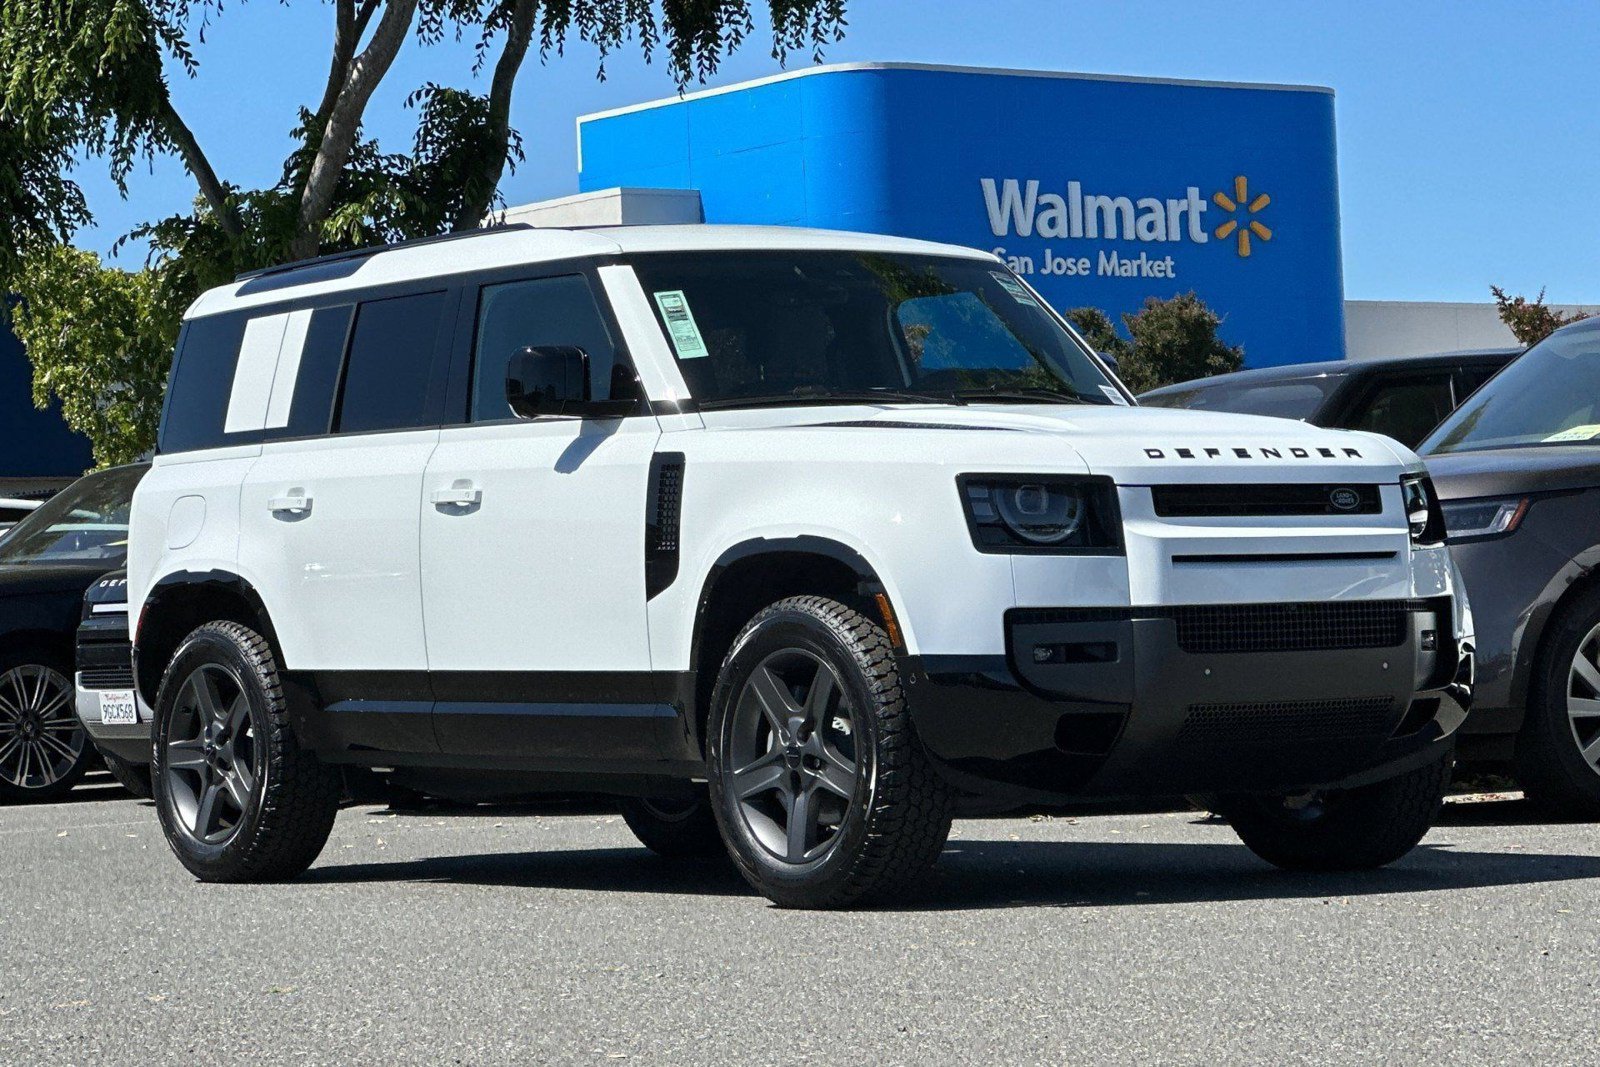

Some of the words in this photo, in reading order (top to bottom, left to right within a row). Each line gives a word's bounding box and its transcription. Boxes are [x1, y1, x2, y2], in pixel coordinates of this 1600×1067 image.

[980, 178, 1208, 243] Walmart
[1040, 249, 1090, 276] Jose
[1097, 250, 1176, 279] Market
[1143, 448, 1363, 459] DEFENDER
